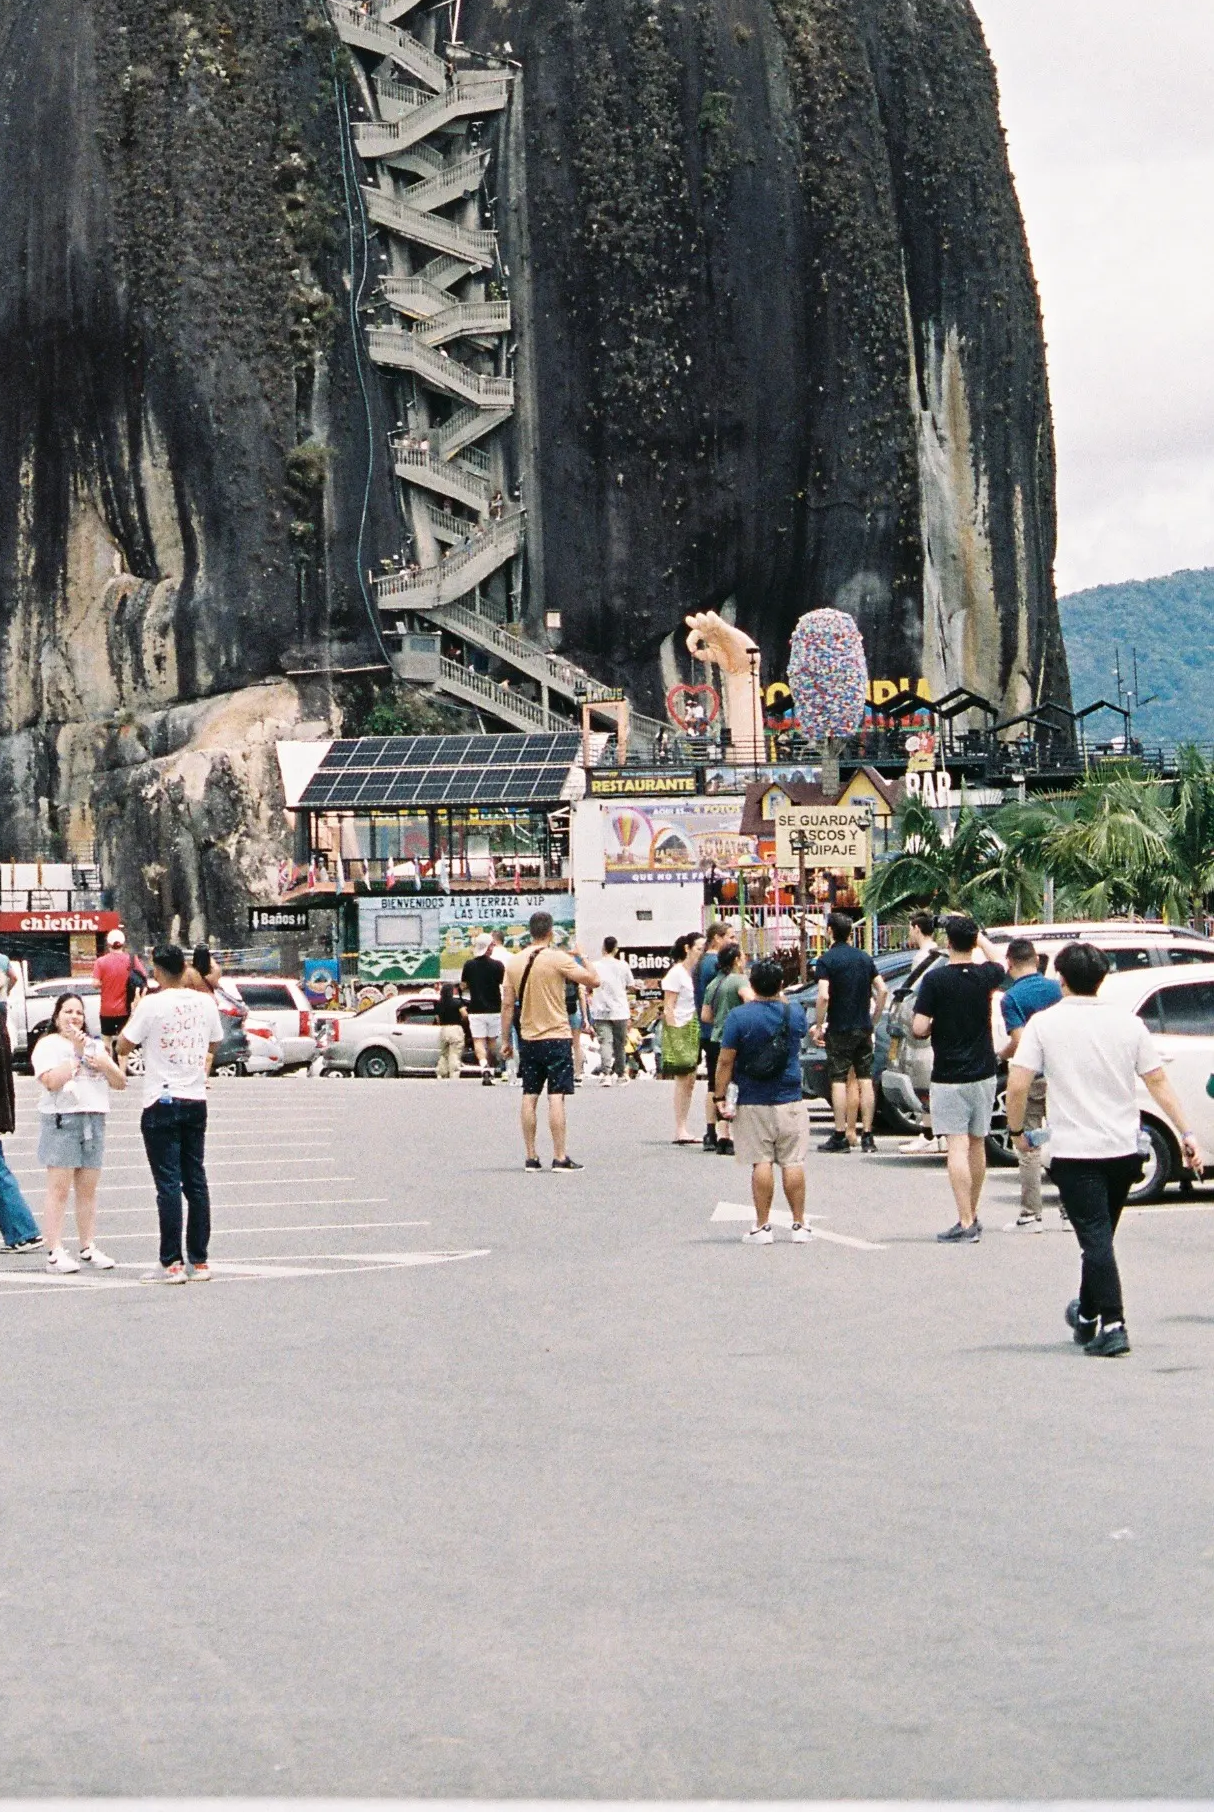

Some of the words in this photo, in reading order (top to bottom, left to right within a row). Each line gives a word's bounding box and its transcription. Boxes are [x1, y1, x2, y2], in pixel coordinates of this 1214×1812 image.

[591, 777, 696, 793] RESTAURANTE
[778, 815, 796, 826] SE
[850, 829, 858, 840] Y
[632, 872, 653, 882] QUE
[381, 897, 445, 909] BIENVENIDOS
[450, 897, 456, 907] A
[459, 897, 471, 907] LA
[476, 896, 520, 907] TERRAZA
[526, 895, 545, 907] VIP
[260, 912, 296, 925] Baños
[454, 909, 473, 919] LAS
[479, 908, 515, 919] LETRAS
[628, 952, 671, 969] Baños
